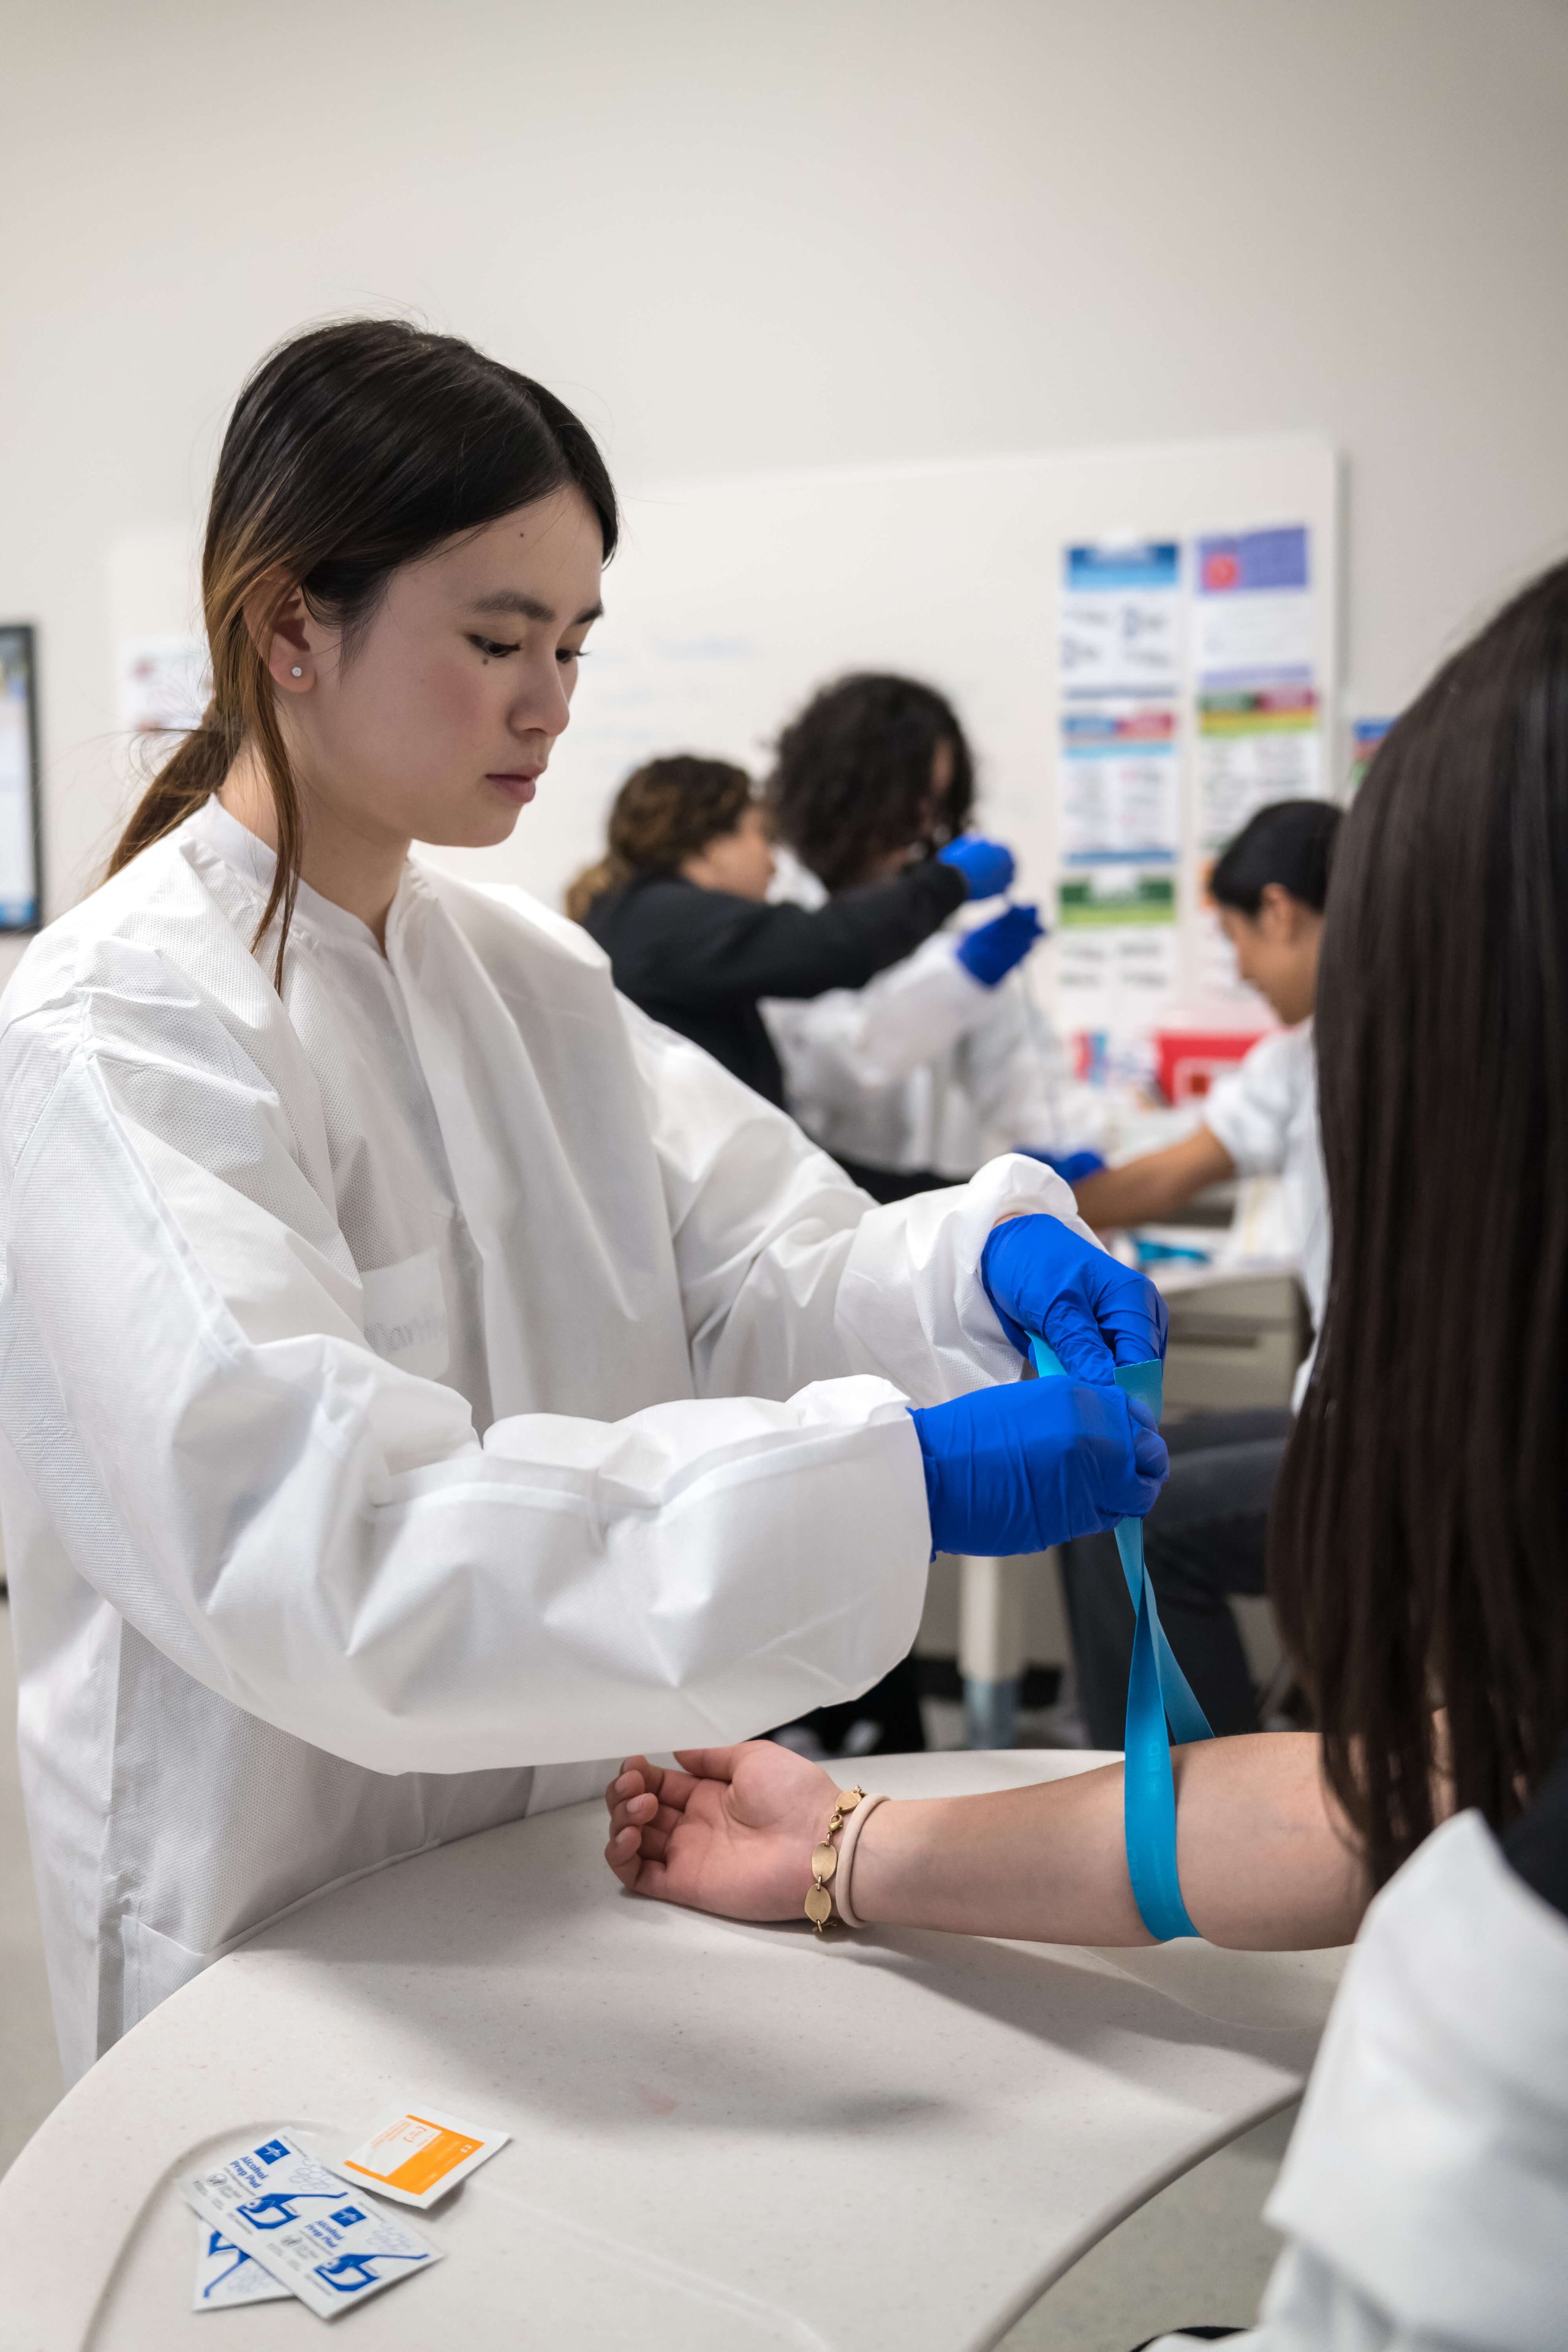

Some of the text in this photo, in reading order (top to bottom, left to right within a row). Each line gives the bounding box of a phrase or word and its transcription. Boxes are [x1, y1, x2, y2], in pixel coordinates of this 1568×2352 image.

[230, 2160, 247, 2176] Prep
[245, 2174, 263, 2188] Pad
[239, 2156, 268, 2179] Alcohol
[304, 2224, 322, 2237] Prep
[315, 2220, 345, 2240] Alcohol
